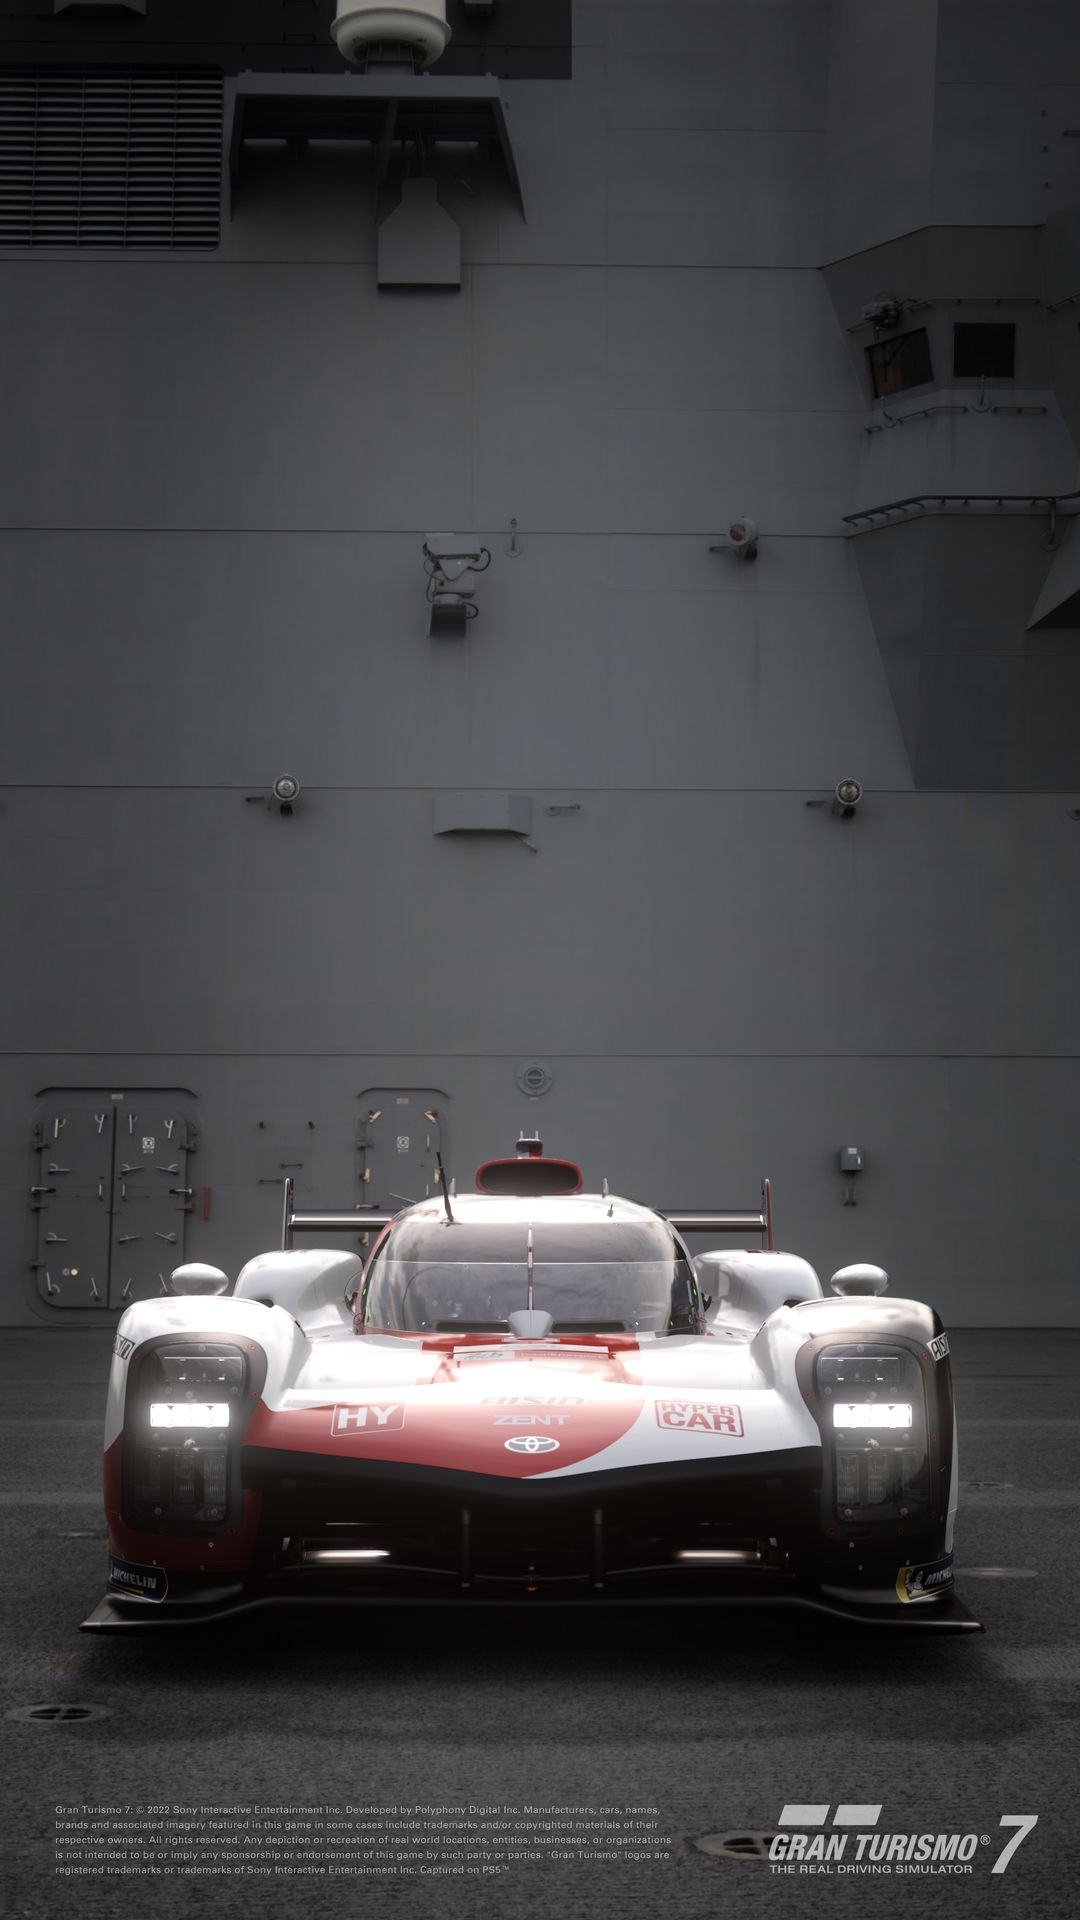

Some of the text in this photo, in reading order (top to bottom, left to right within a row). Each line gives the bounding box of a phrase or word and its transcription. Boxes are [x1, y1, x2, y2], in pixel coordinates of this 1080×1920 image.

[337, 1402, 399, 1430] HY
[662, 1402, 733, 1416] HYPER
[493, 1413, 571, 1426] ZENT
[661, 1411, 738, 1433] CAR
